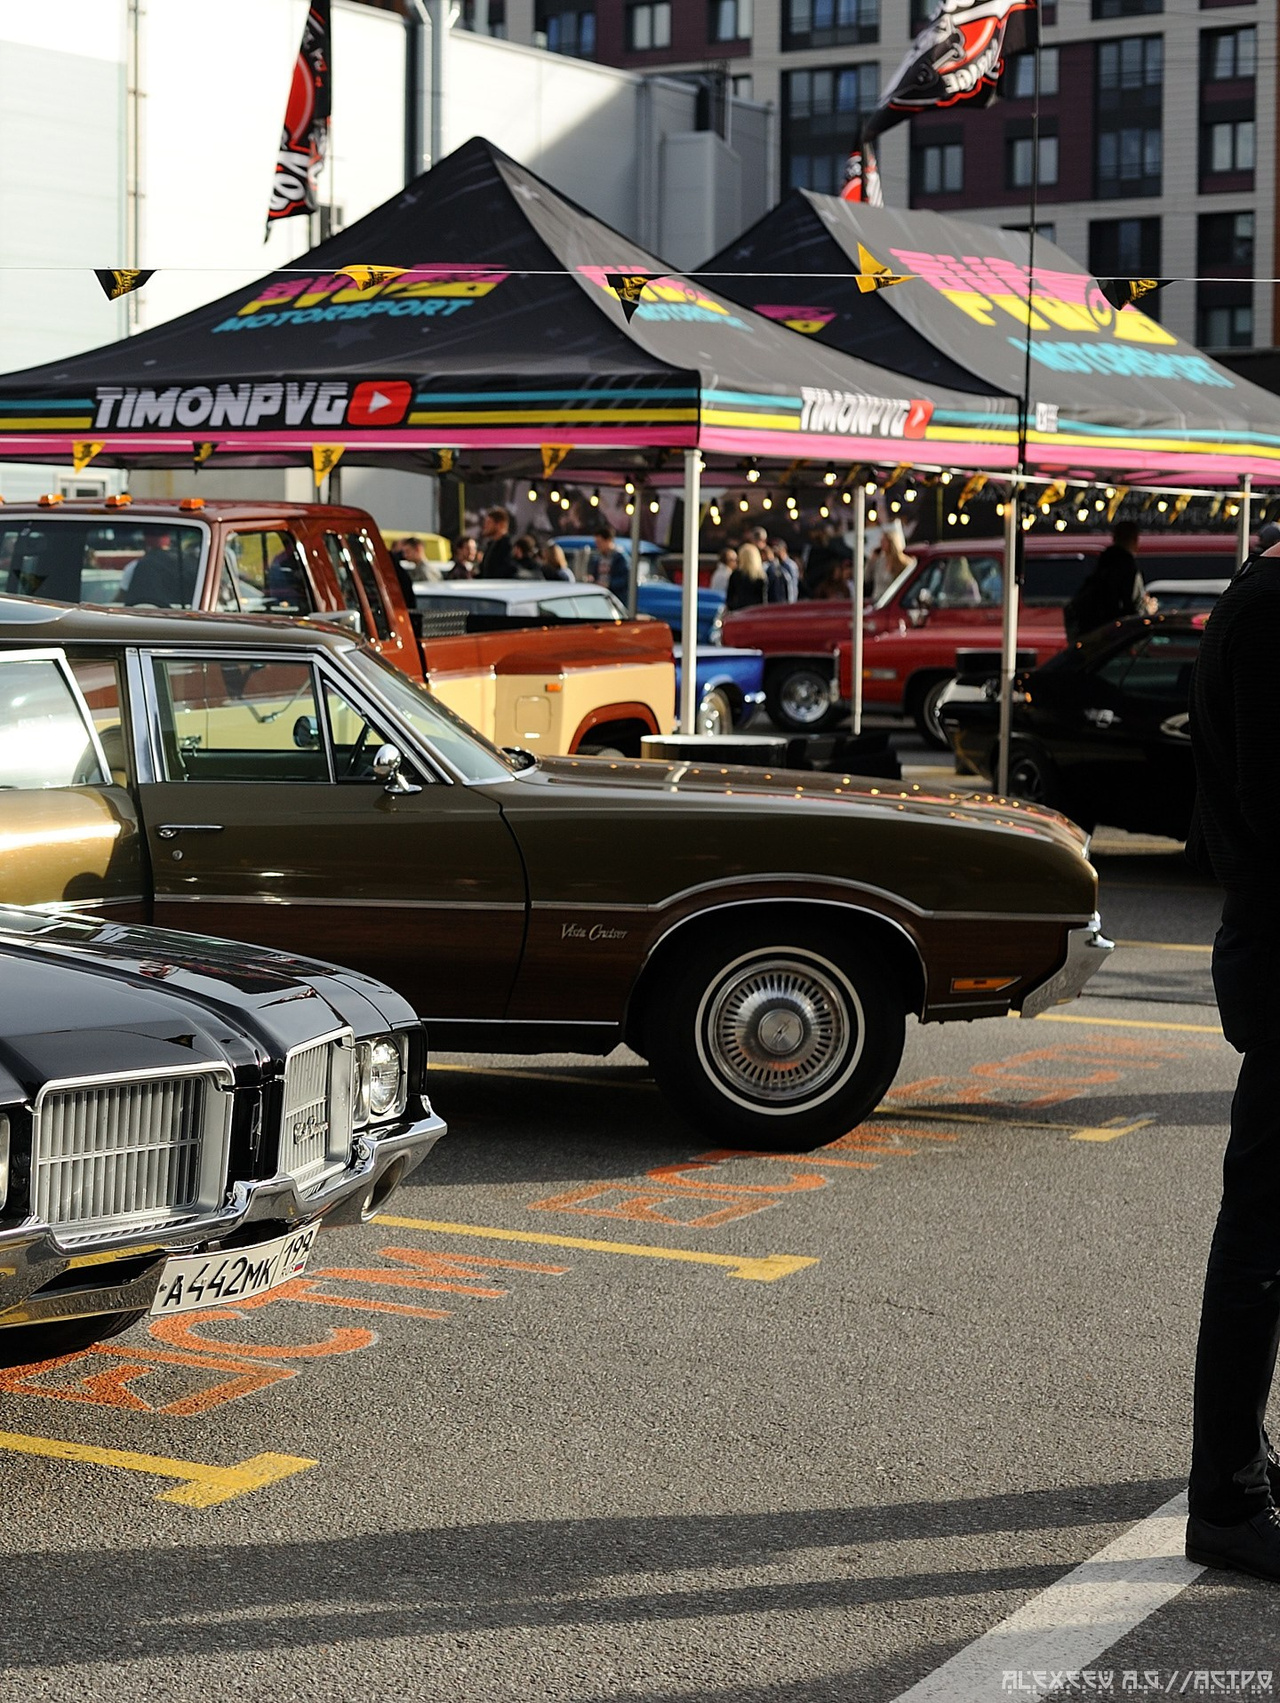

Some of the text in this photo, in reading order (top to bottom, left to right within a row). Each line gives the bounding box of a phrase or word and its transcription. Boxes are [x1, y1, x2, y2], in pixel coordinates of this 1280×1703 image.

[211, 299, 474, 333] MOTORSPORT
[95, 382, 348, 428] TIMONPVG
[561, 923, 628, 941] Vista Cruiser
[283, 1230, 314, 1268] 199
